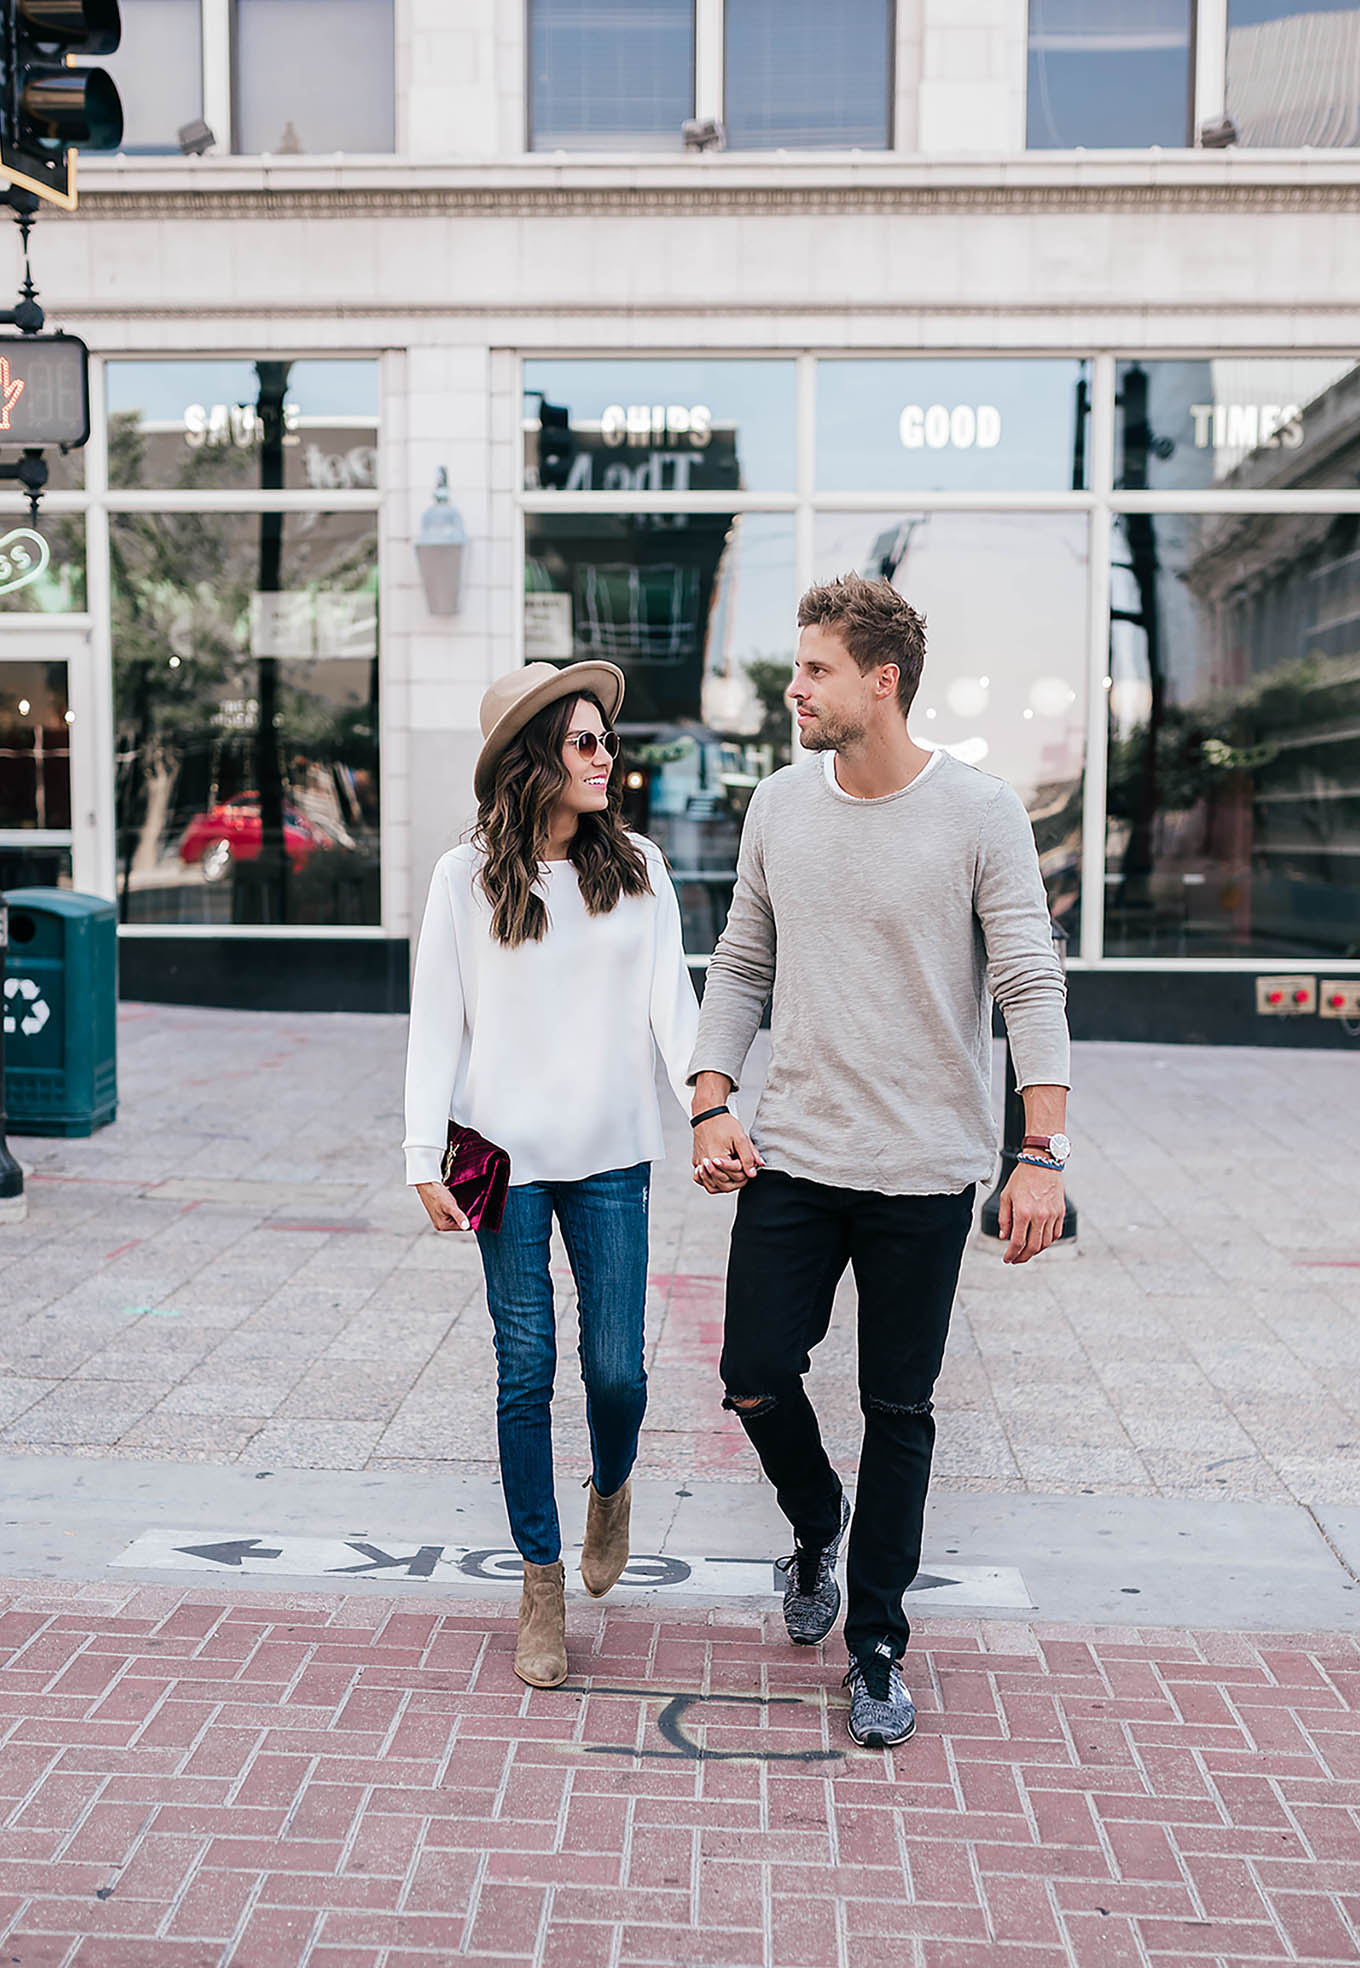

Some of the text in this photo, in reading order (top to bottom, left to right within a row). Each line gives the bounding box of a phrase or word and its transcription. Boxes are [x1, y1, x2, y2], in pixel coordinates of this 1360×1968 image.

[601, 405, 712, 448] CHIPS
[899, 403, 1001, 449] GOOD
[1190, 404, 1304, 449] TIMES
